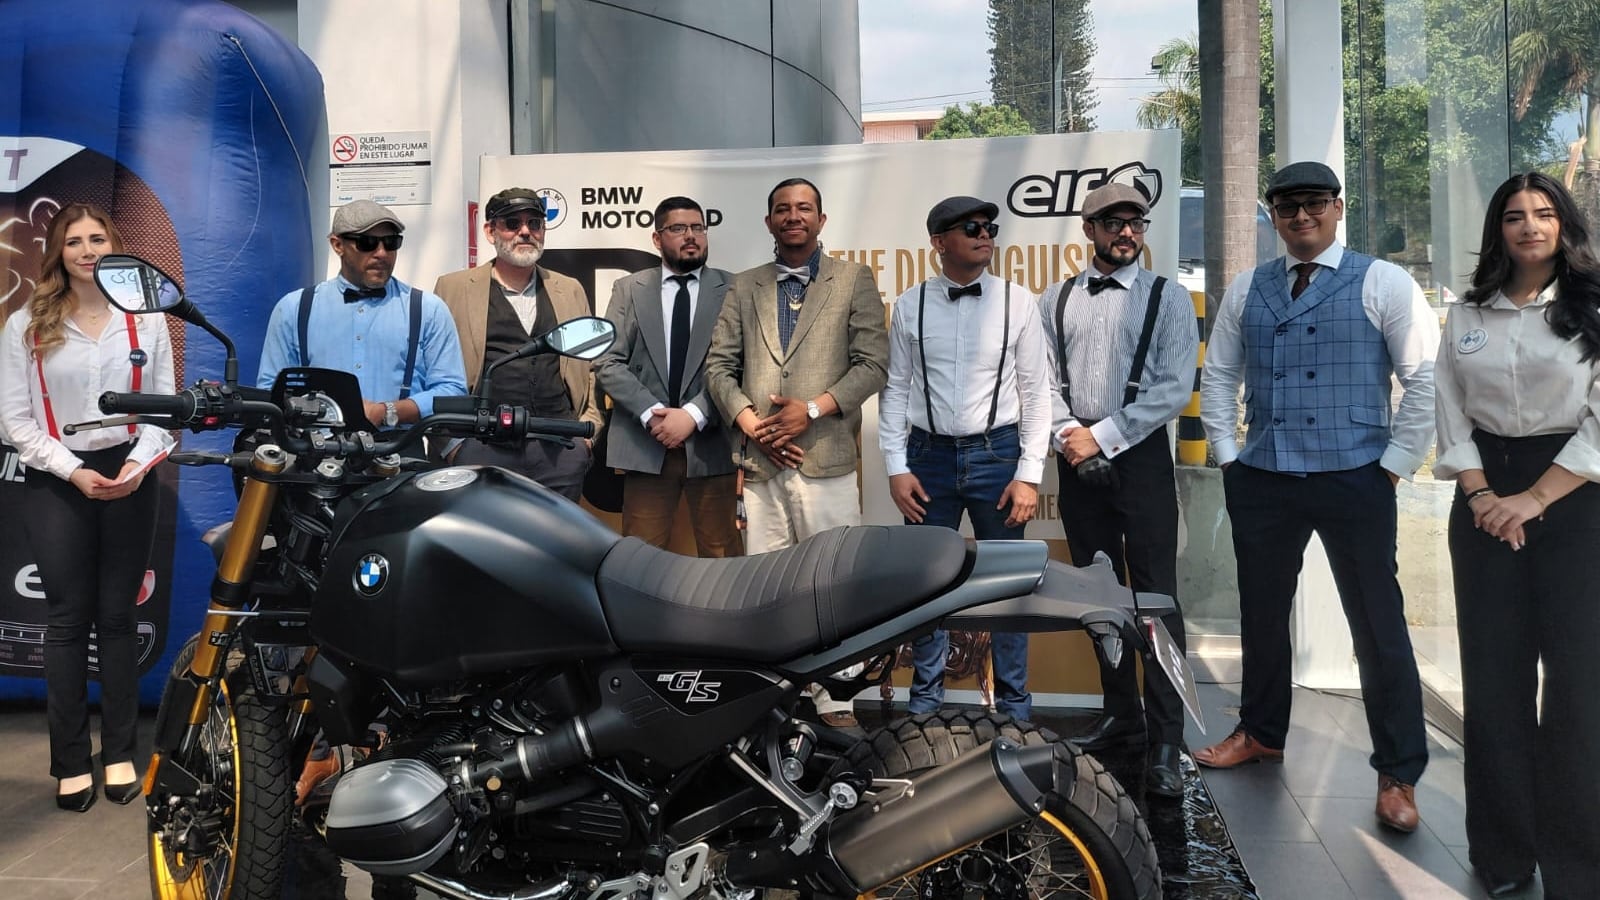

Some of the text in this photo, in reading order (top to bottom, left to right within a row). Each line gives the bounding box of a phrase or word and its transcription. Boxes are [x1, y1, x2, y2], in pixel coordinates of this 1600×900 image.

[360, 136, 385, 144] QUEDA
[360, 142, 427, 151] PROHIBIDO FUMAR
[371, 151, 389, 159] ESTE
[581, 186, 643, 205] BMW
[1007, 168, 1108, 217] elf
[581, 209, 723, 229] MOTOD
